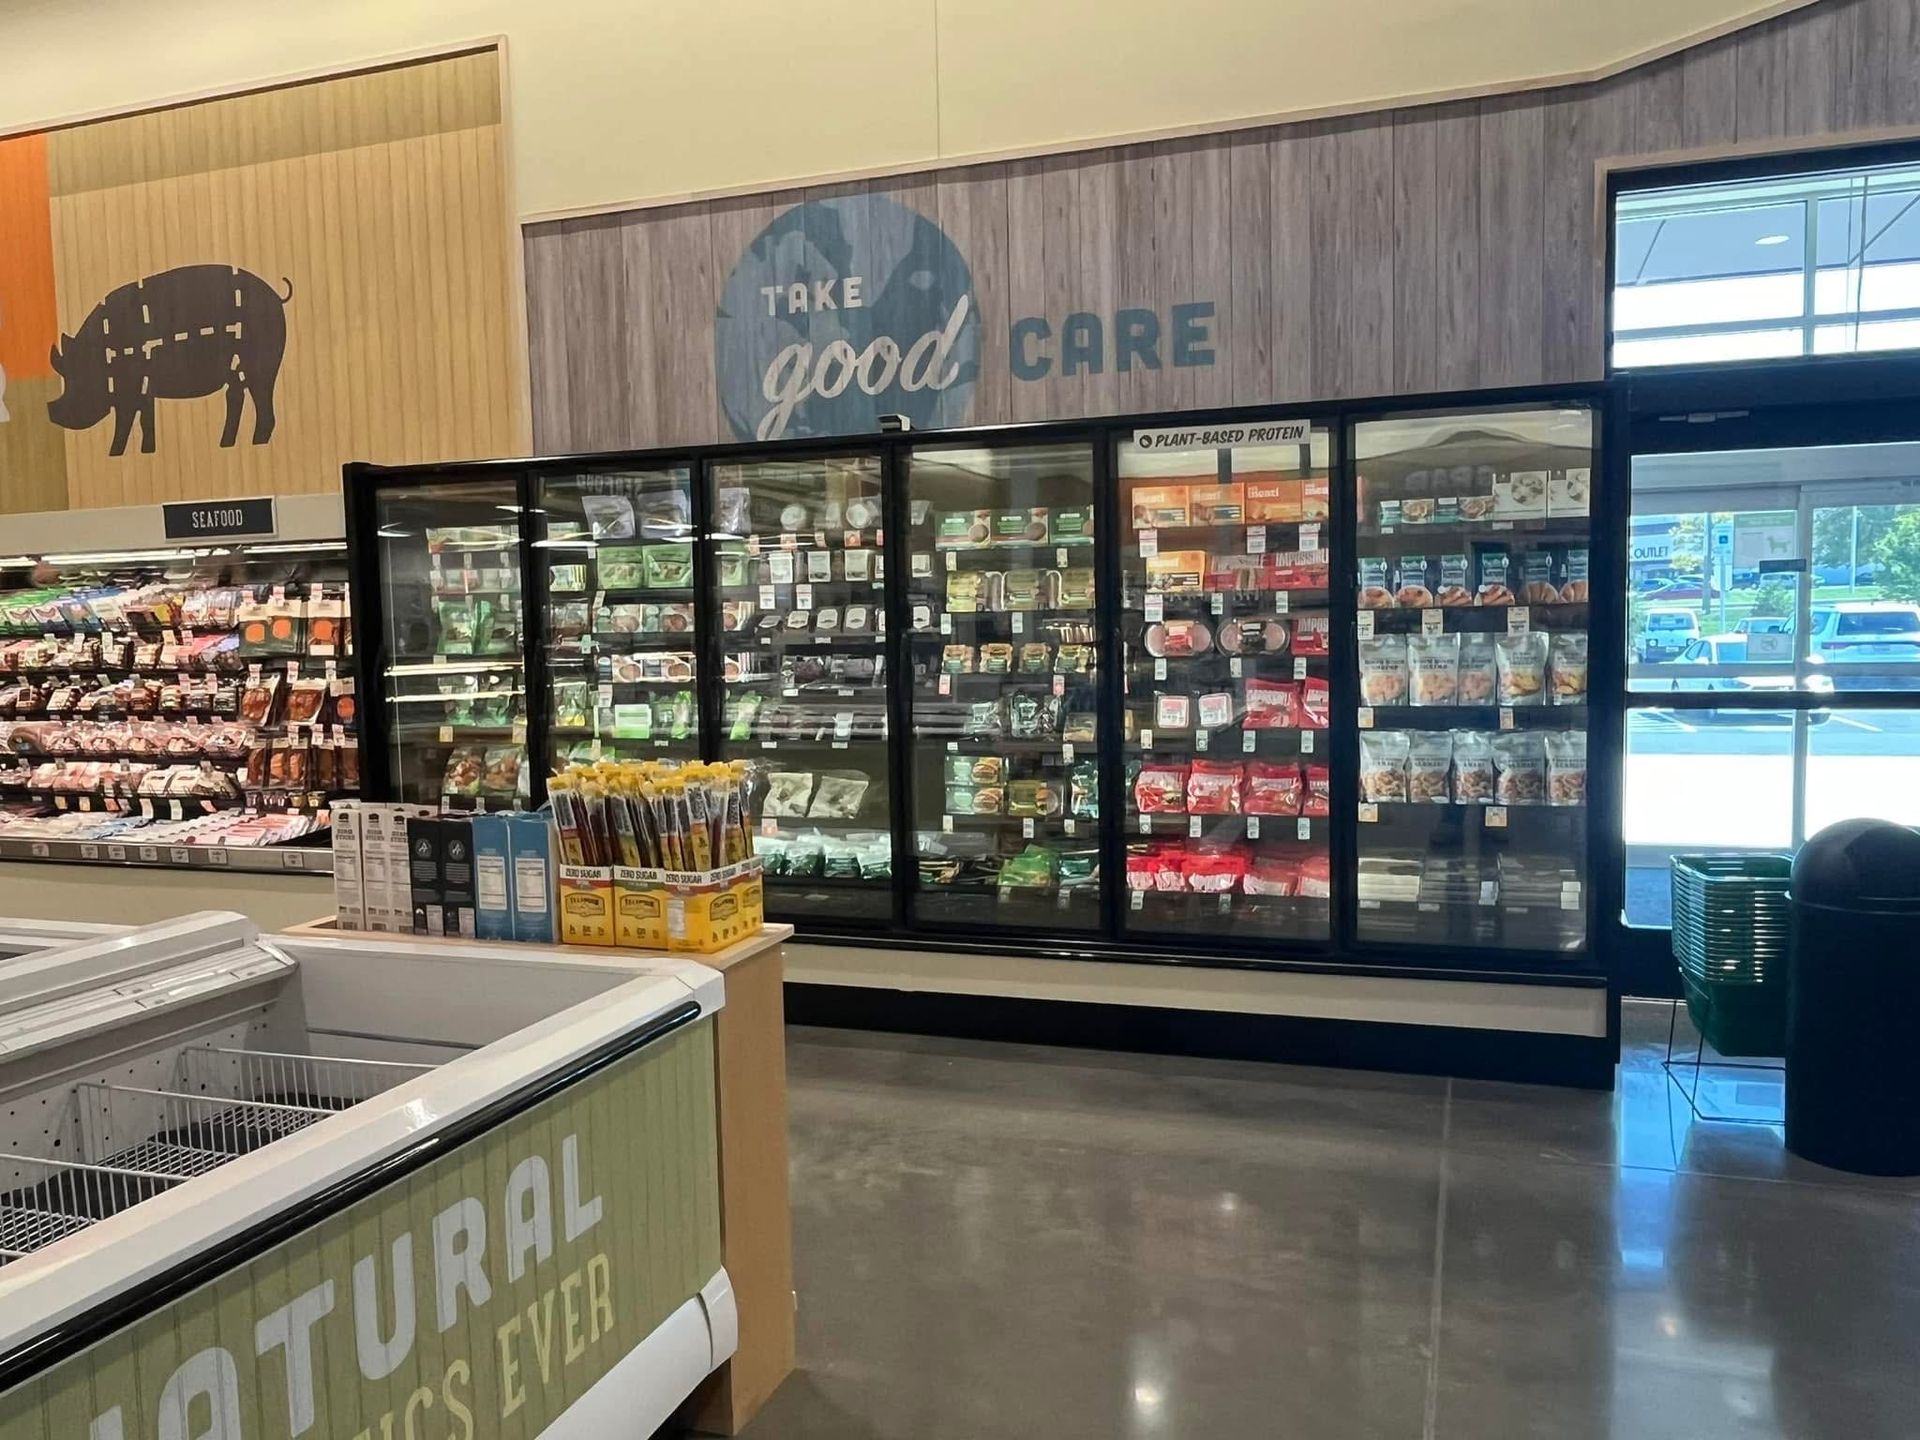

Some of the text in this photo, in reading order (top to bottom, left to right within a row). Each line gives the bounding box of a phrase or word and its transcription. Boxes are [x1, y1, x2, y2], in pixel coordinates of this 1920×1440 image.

[761, 277, 863, 316] TAKE
[756, 294, 1215, 441] good CARE
[1154, 426, 1304, 448] PLANT-BASED PROTEIN
[191, 509, 243, 529] SEAFOOD
[1633, 546, 1669, 560] OUTLET
[565, 868, 601, 879] ZERO SUGAR
[620, 869, 657, 880] ZERO SUGAR
[665, 873, 703, 884] ZERO SUGAR
[90, 1134, 602, 1440] ATURAL
[497, 1253, 614, 1418] EVER
